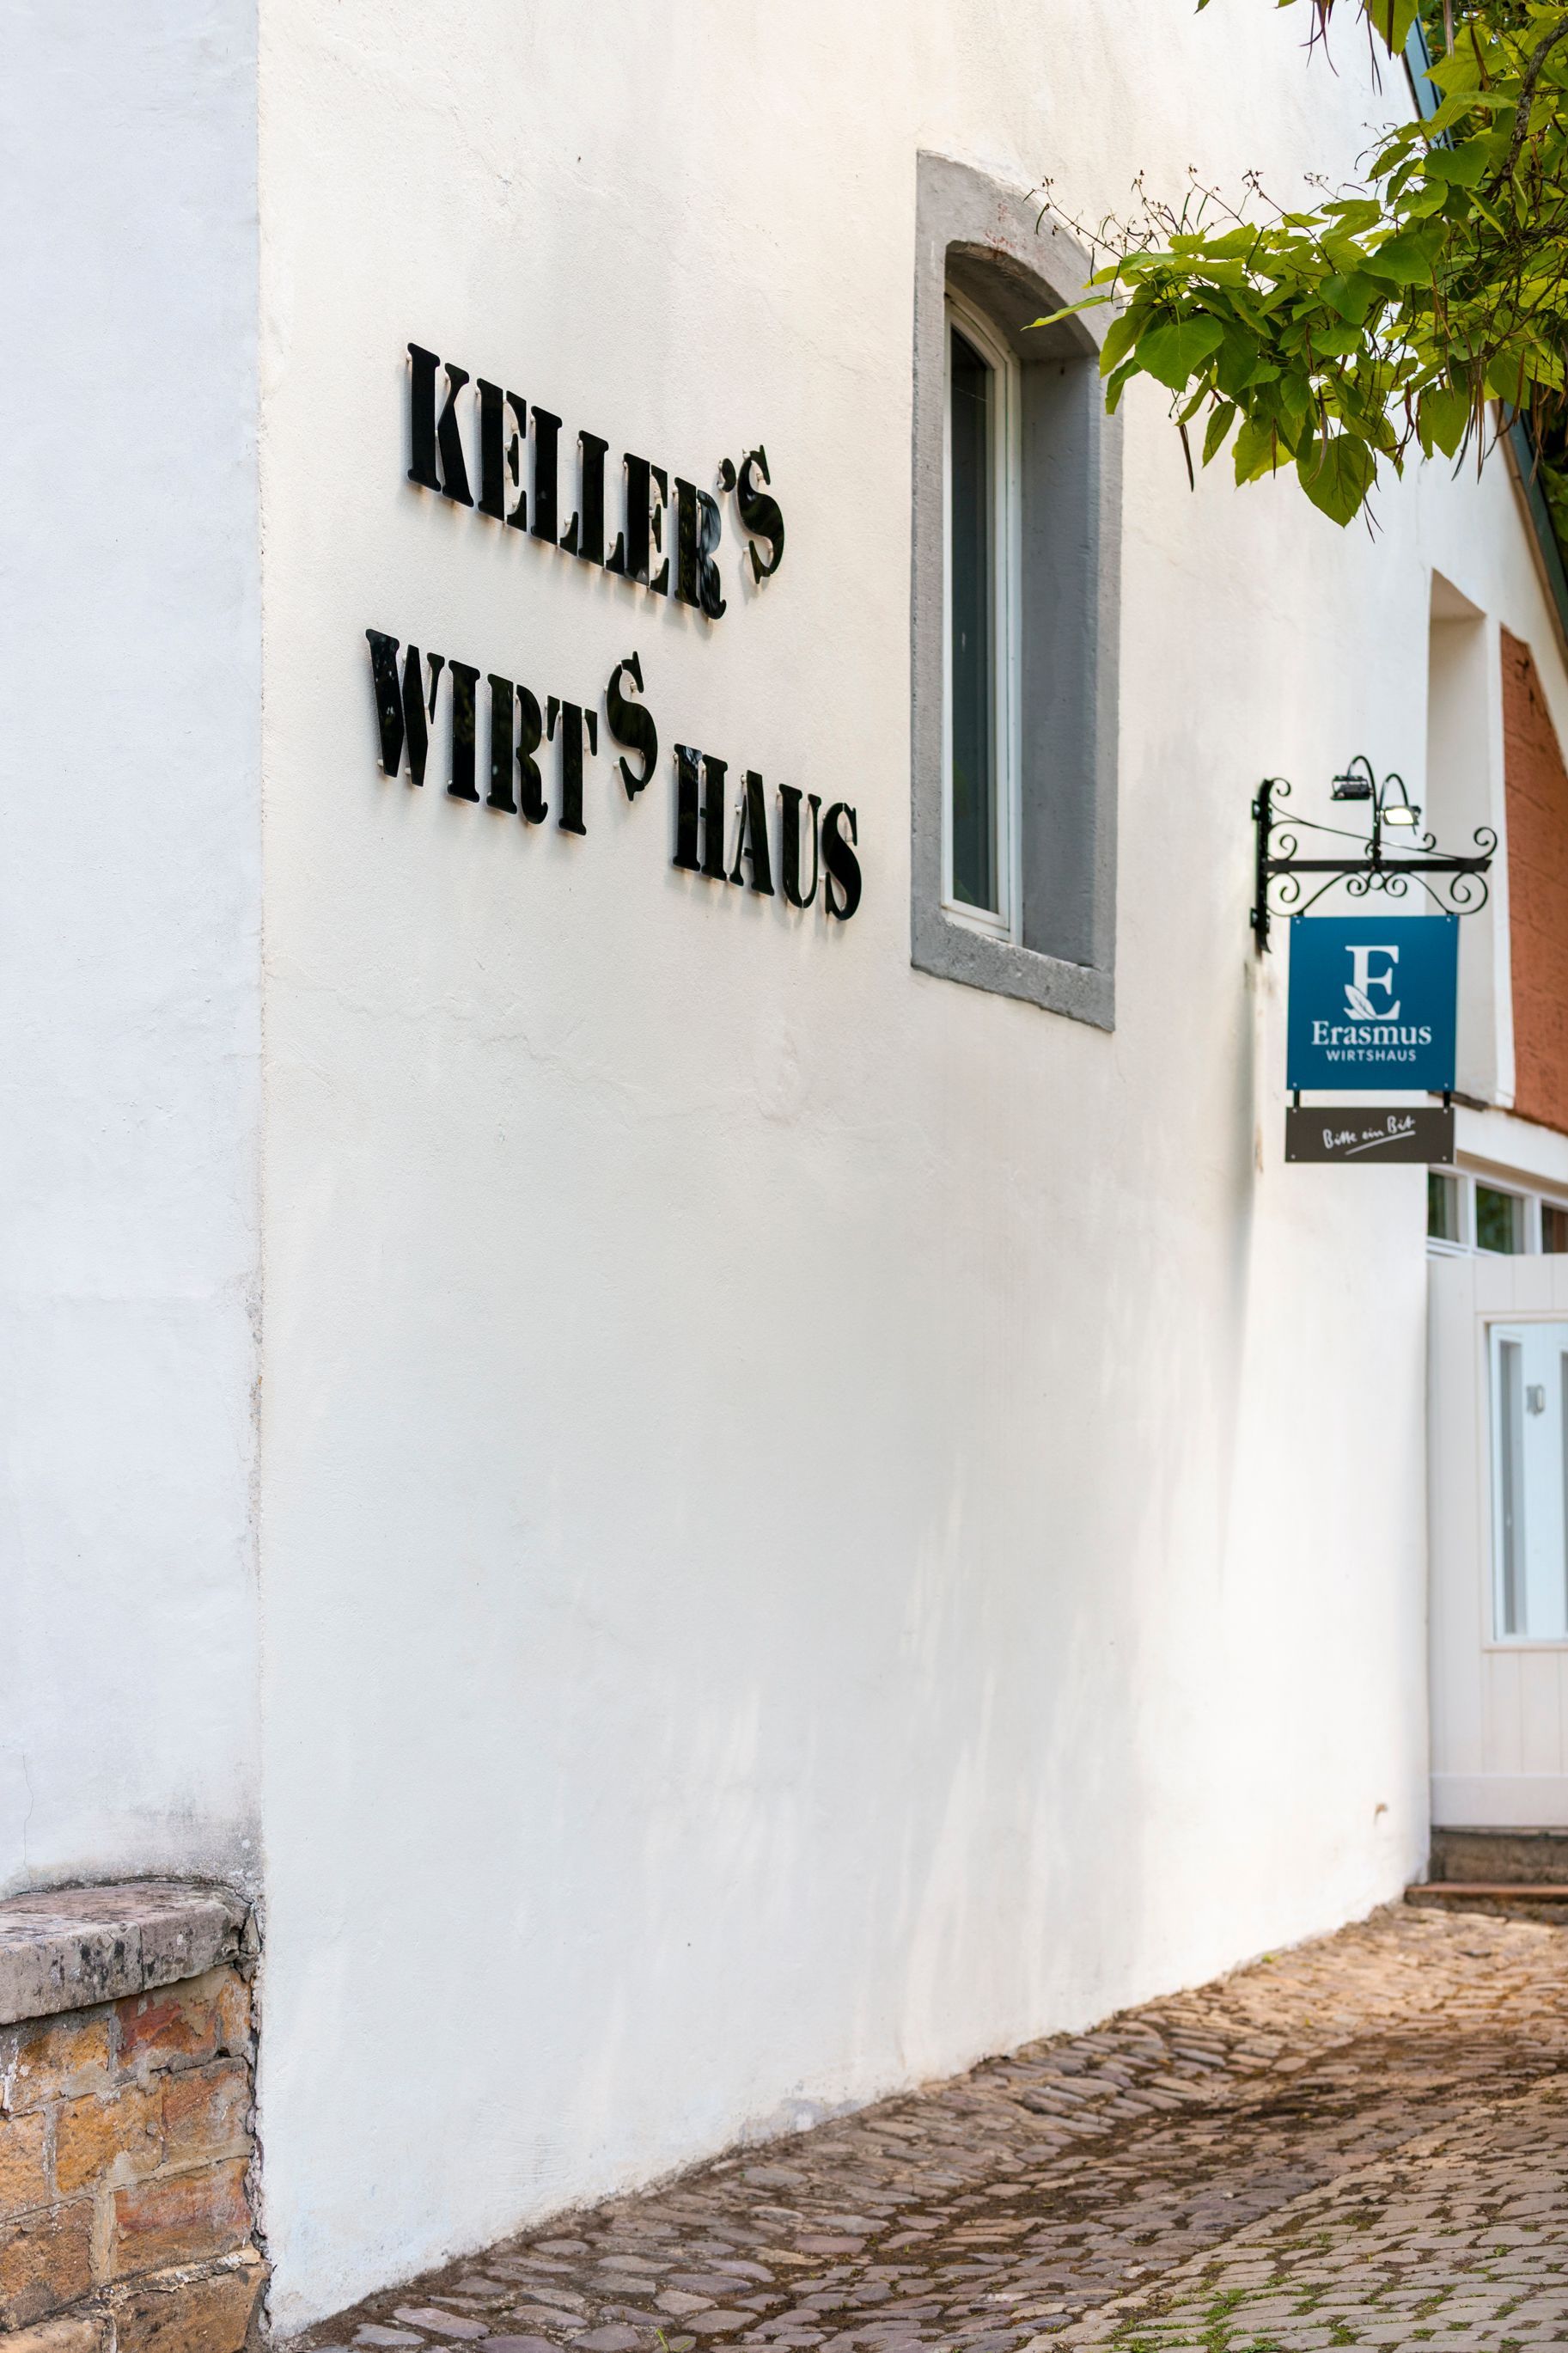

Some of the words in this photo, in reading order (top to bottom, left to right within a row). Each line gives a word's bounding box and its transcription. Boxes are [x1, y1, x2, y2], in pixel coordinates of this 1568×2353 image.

[1311, 1020, 1432, 1046] Erasmus
[1326, 1049, 1417, 1062] WIRTSHAUS
[1322, 1128, 1358, 1150] Bitte
[1362, 1127, 1384, 1140] ein
[1387, 1115, 1416, 1134] Bit
